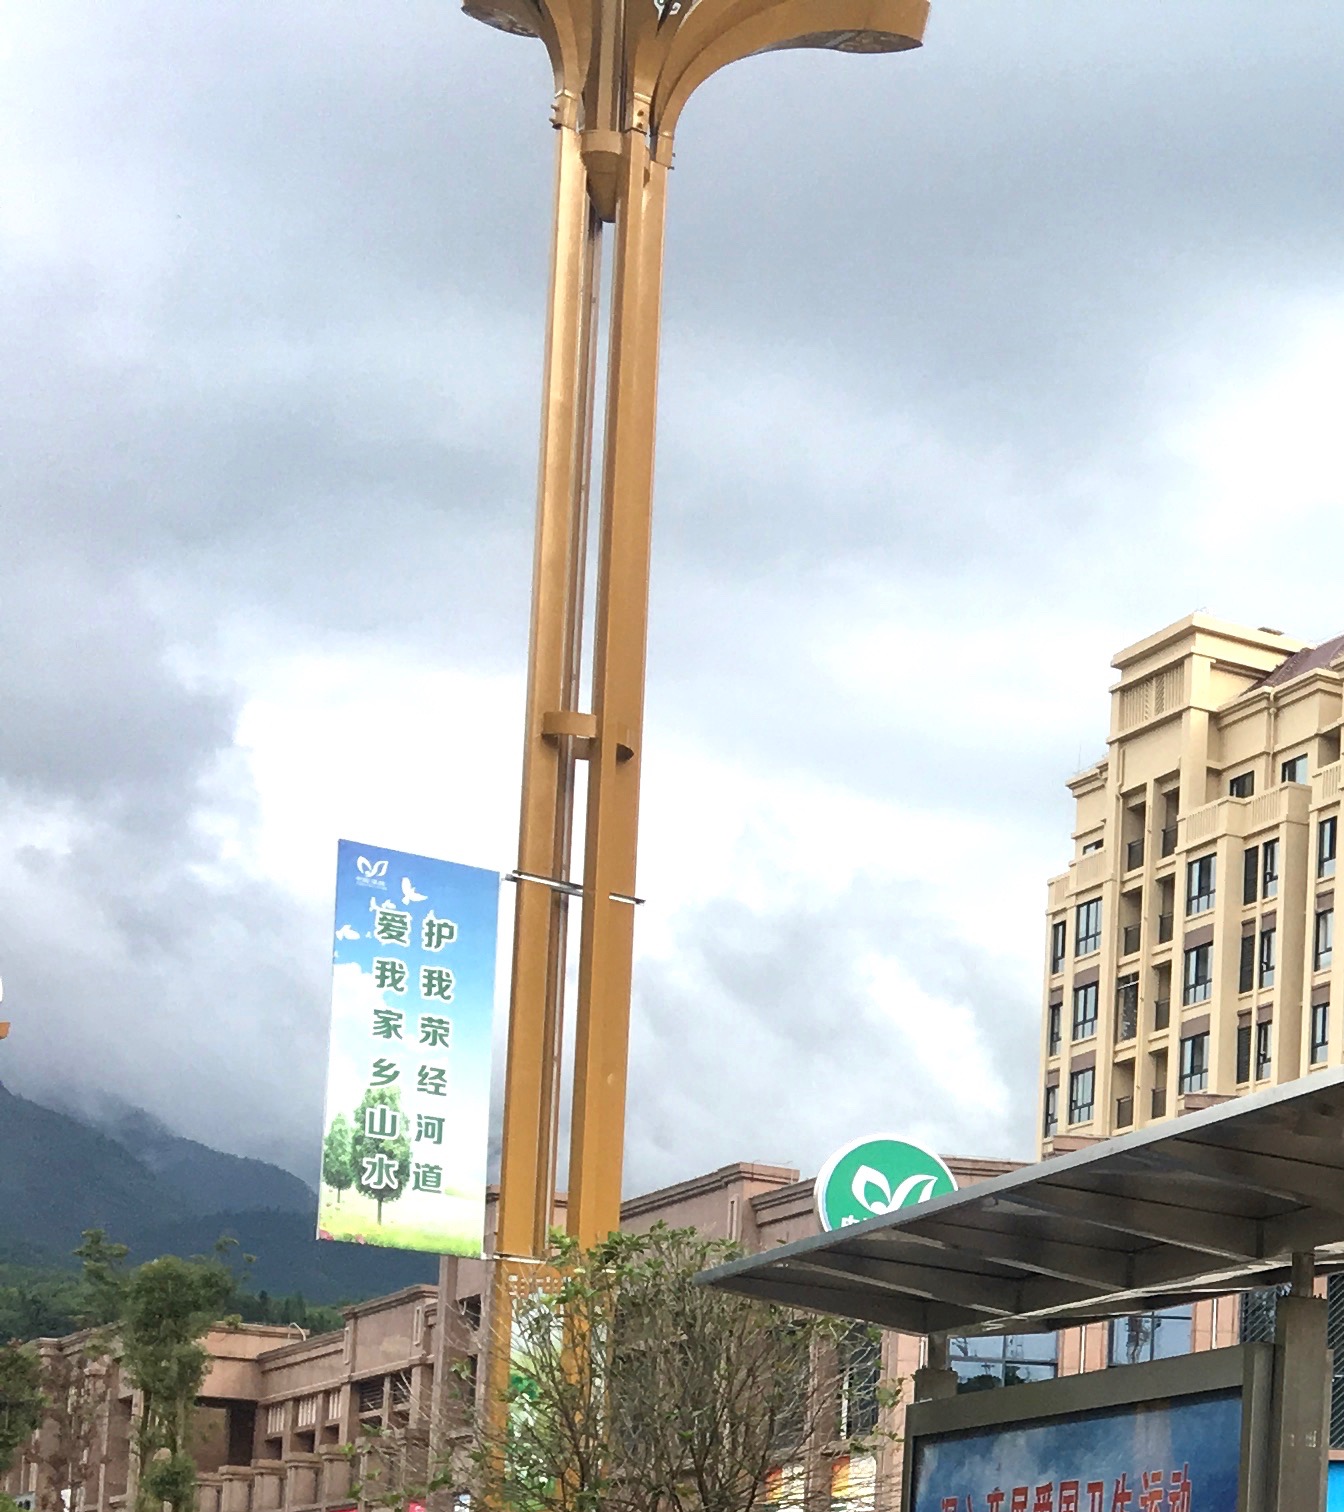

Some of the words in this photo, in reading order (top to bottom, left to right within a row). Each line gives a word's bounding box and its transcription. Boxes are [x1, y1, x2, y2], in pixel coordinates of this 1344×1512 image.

[364, 909, 409, 1190] 爱我家乡山水
[411, 918, 455, 1195] 护我荥经河道
